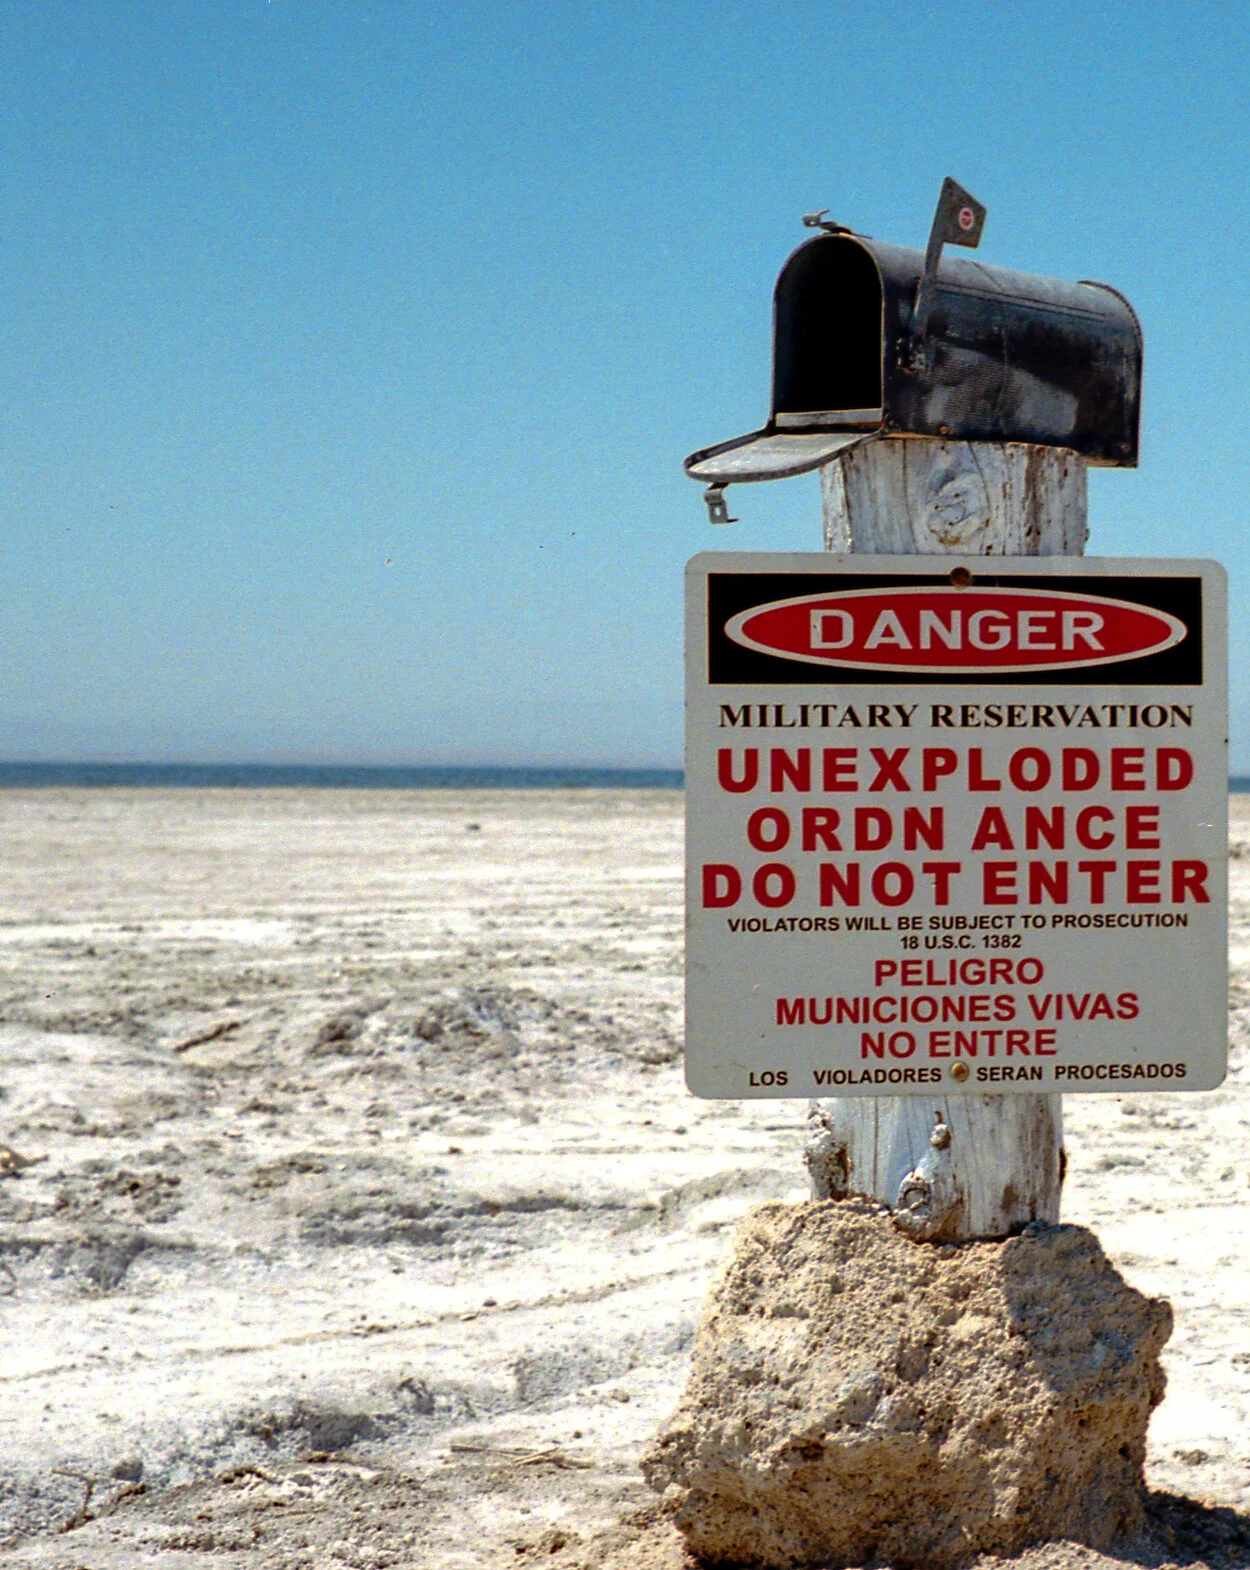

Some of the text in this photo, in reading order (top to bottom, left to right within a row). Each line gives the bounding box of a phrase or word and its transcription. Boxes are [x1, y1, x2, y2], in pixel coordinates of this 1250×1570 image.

[809, 609, 1105, 651] DANGER
[719, 704, 1192, 728] MILITARY RESERVATION
[717, 747, 1194, 794] UNEXPLODED
[702, 859, 1211, 909] DO NOT ENTER
[727, 913, 1188, 933] VIOLATORS WILL BE SUBJECT TO PROSECUTION
[900, 934, 1022, 950] 18 U.S.C. 1382
[875, 957, 1044, 987] PELIGRO
[776, 992, 1140, 1026] MUNICIONES VIVAS
[861, 1028, 1057, 1059] NO ENTRE
[749, 1063, 1187, 1087] LOS VIOLADORES SERAN PROCESADOS
